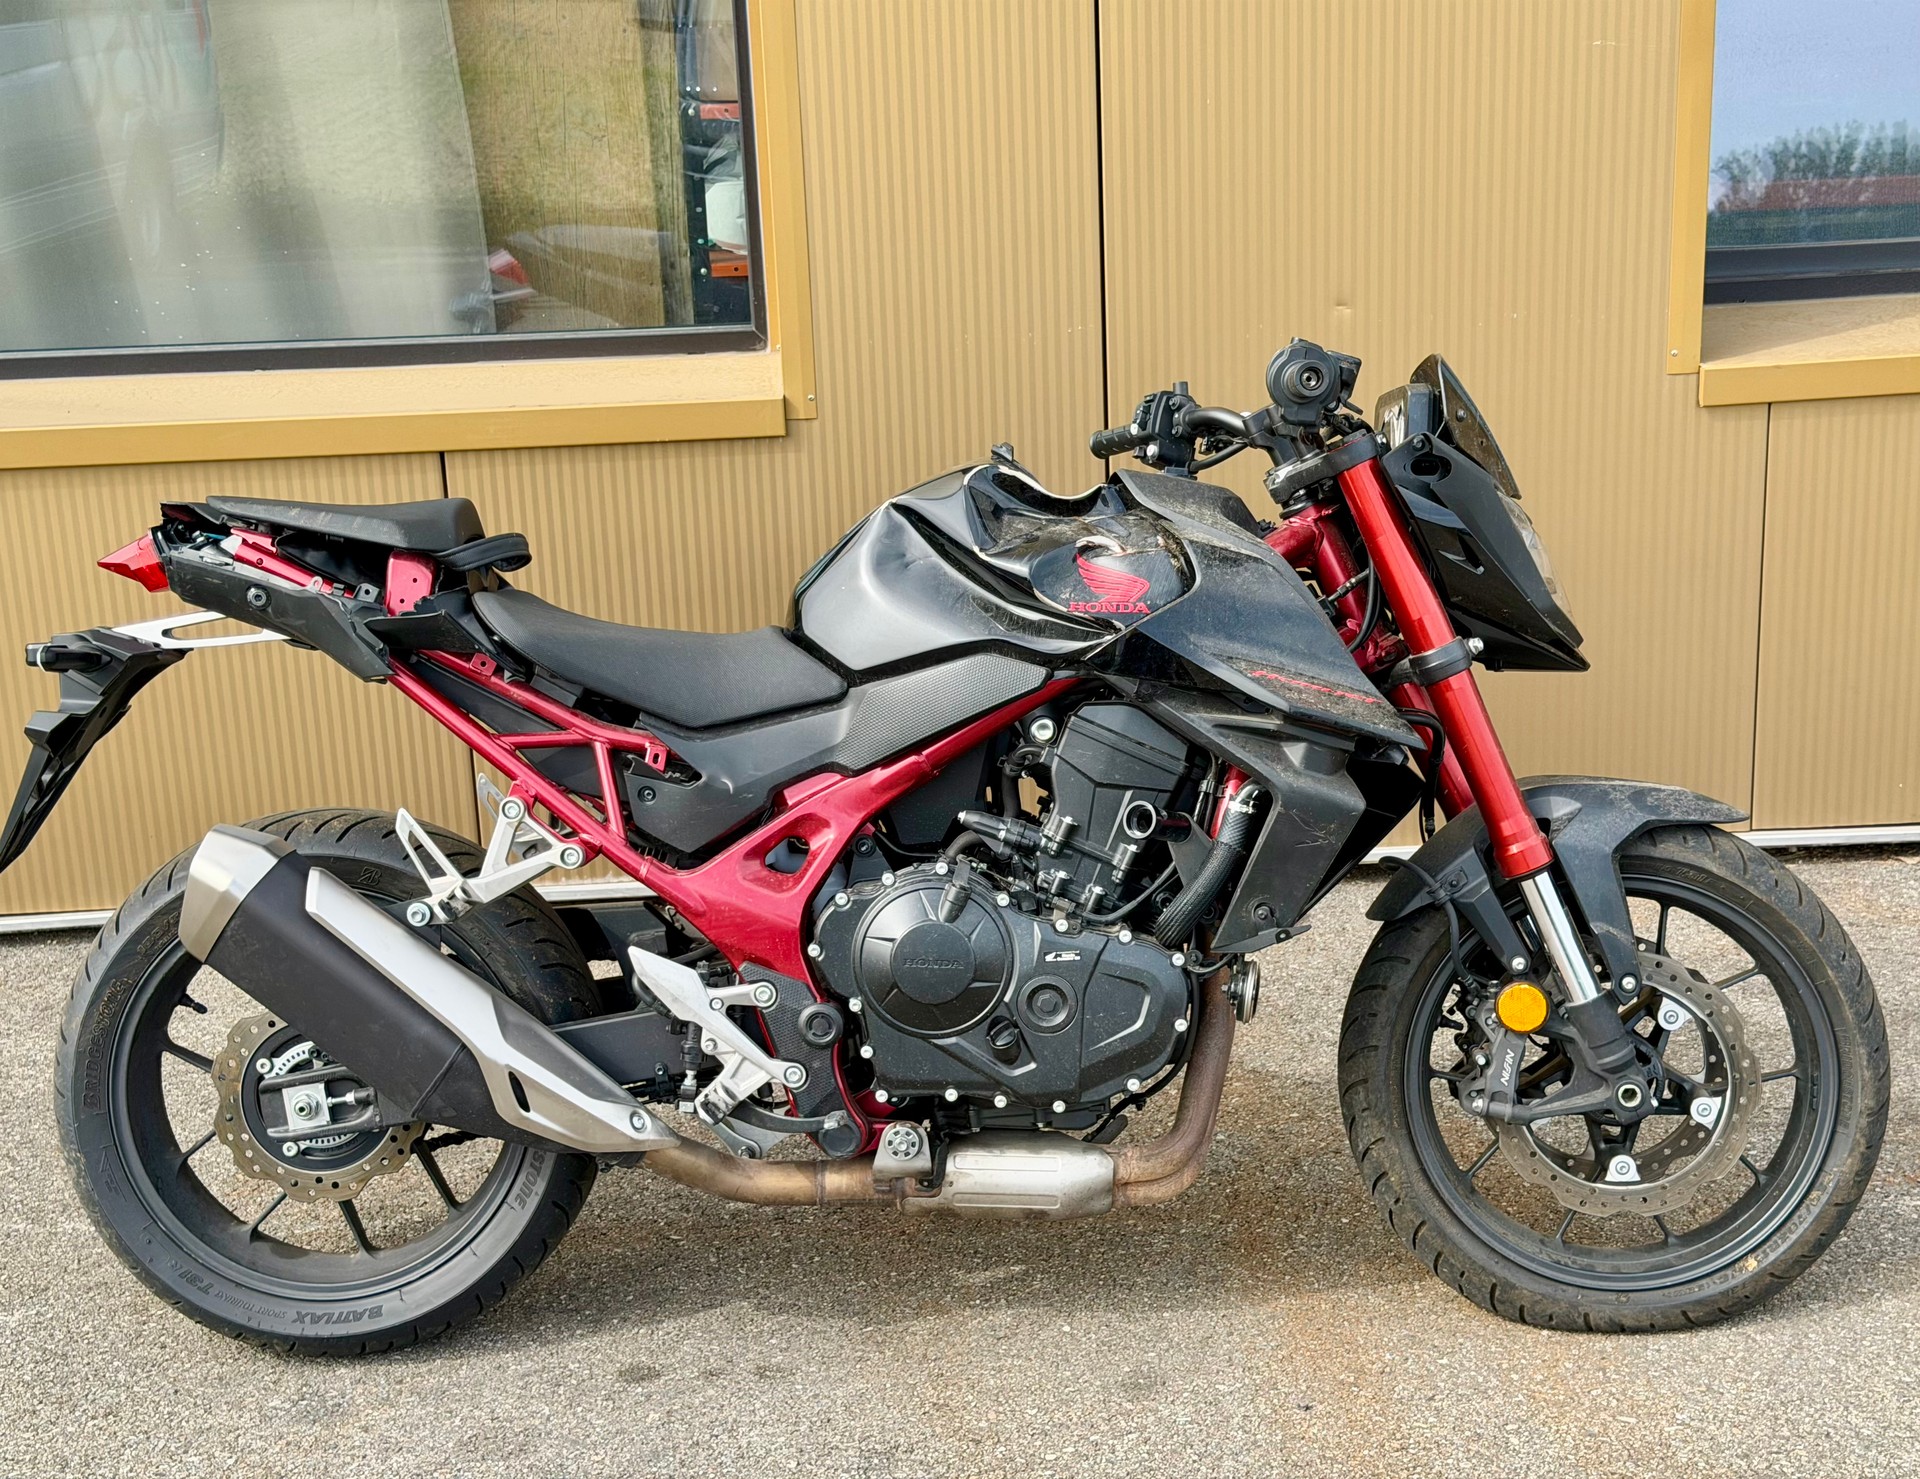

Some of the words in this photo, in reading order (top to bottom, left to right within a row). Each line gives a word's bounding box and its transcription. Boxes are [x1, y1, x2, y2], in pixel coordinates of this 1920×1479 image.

[1067, 601, 1151, 615] HONDA
[903, 957, 965, 969] HONDA
[81, 977, 125, 1110] BRIDGESTONE
[291, 1304, 384, 1325] BATTLAX
